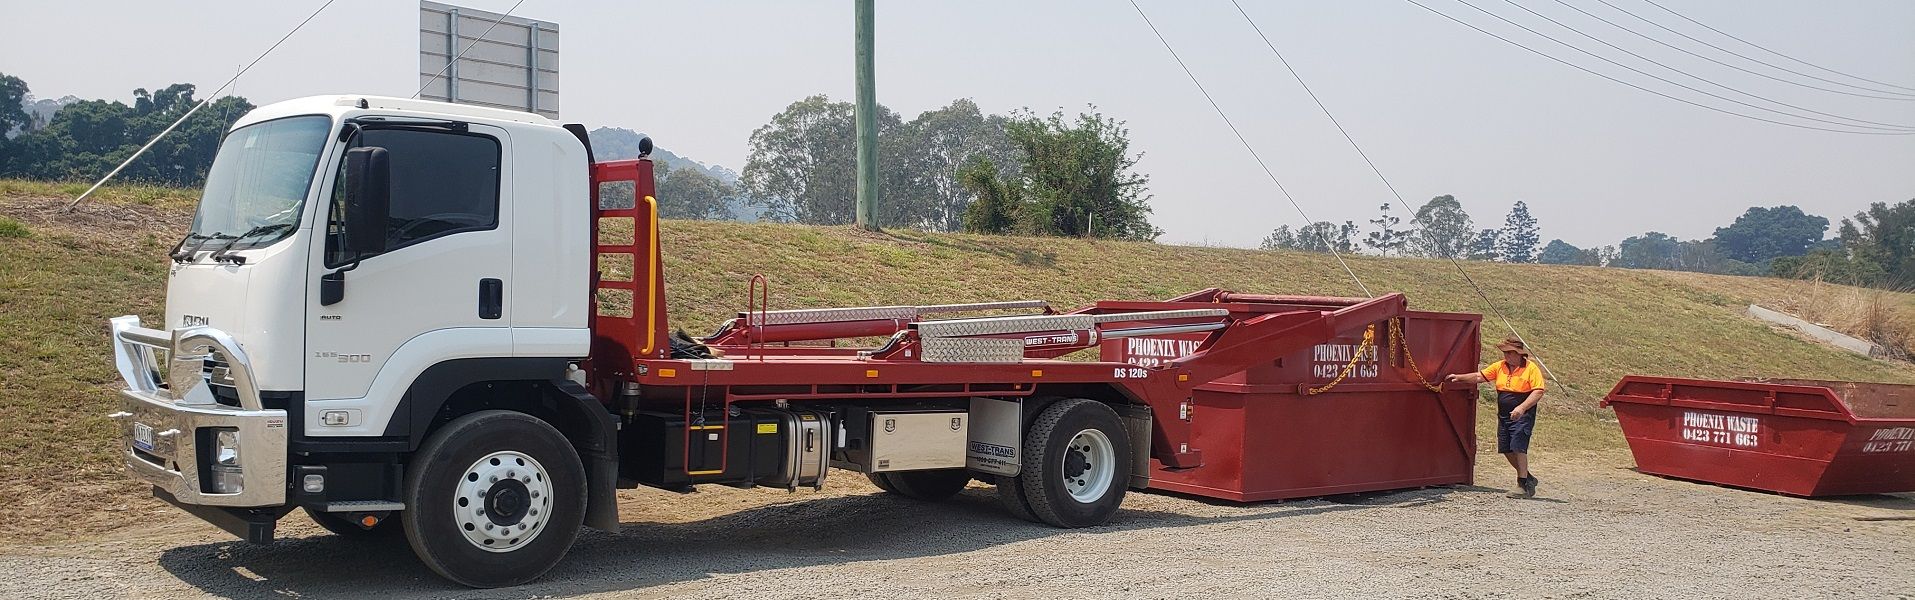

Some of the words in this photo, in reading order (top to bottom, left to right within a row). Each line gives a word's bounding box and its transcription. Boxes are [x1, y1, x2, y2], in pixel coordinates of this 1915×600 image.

[1026, 335, 1077, 345] WEST-TRANS
[1127, 337, 1175, 357] PHOENIX
[1178, 340, 1204, 358] WAS
[1314, 344, 1351, 361] PHOENIX
[338, 353, 371, 363] 300
[1114, 368, 1126, 378] DS
[1128, 368, 1148, 378] 120s
[1314, 364, 1338, 378] 0423
[1684, 412, 1724, 430] PHOENIX
[1727, 416, 1759, 433] WASTE
[1683, 428, 1710, 442] 0423
[1713, 431, 1731, 444] 771
[1736, 433, 1758, 447] 663
[971, 443, 1014, 456] WEST-TRANS
